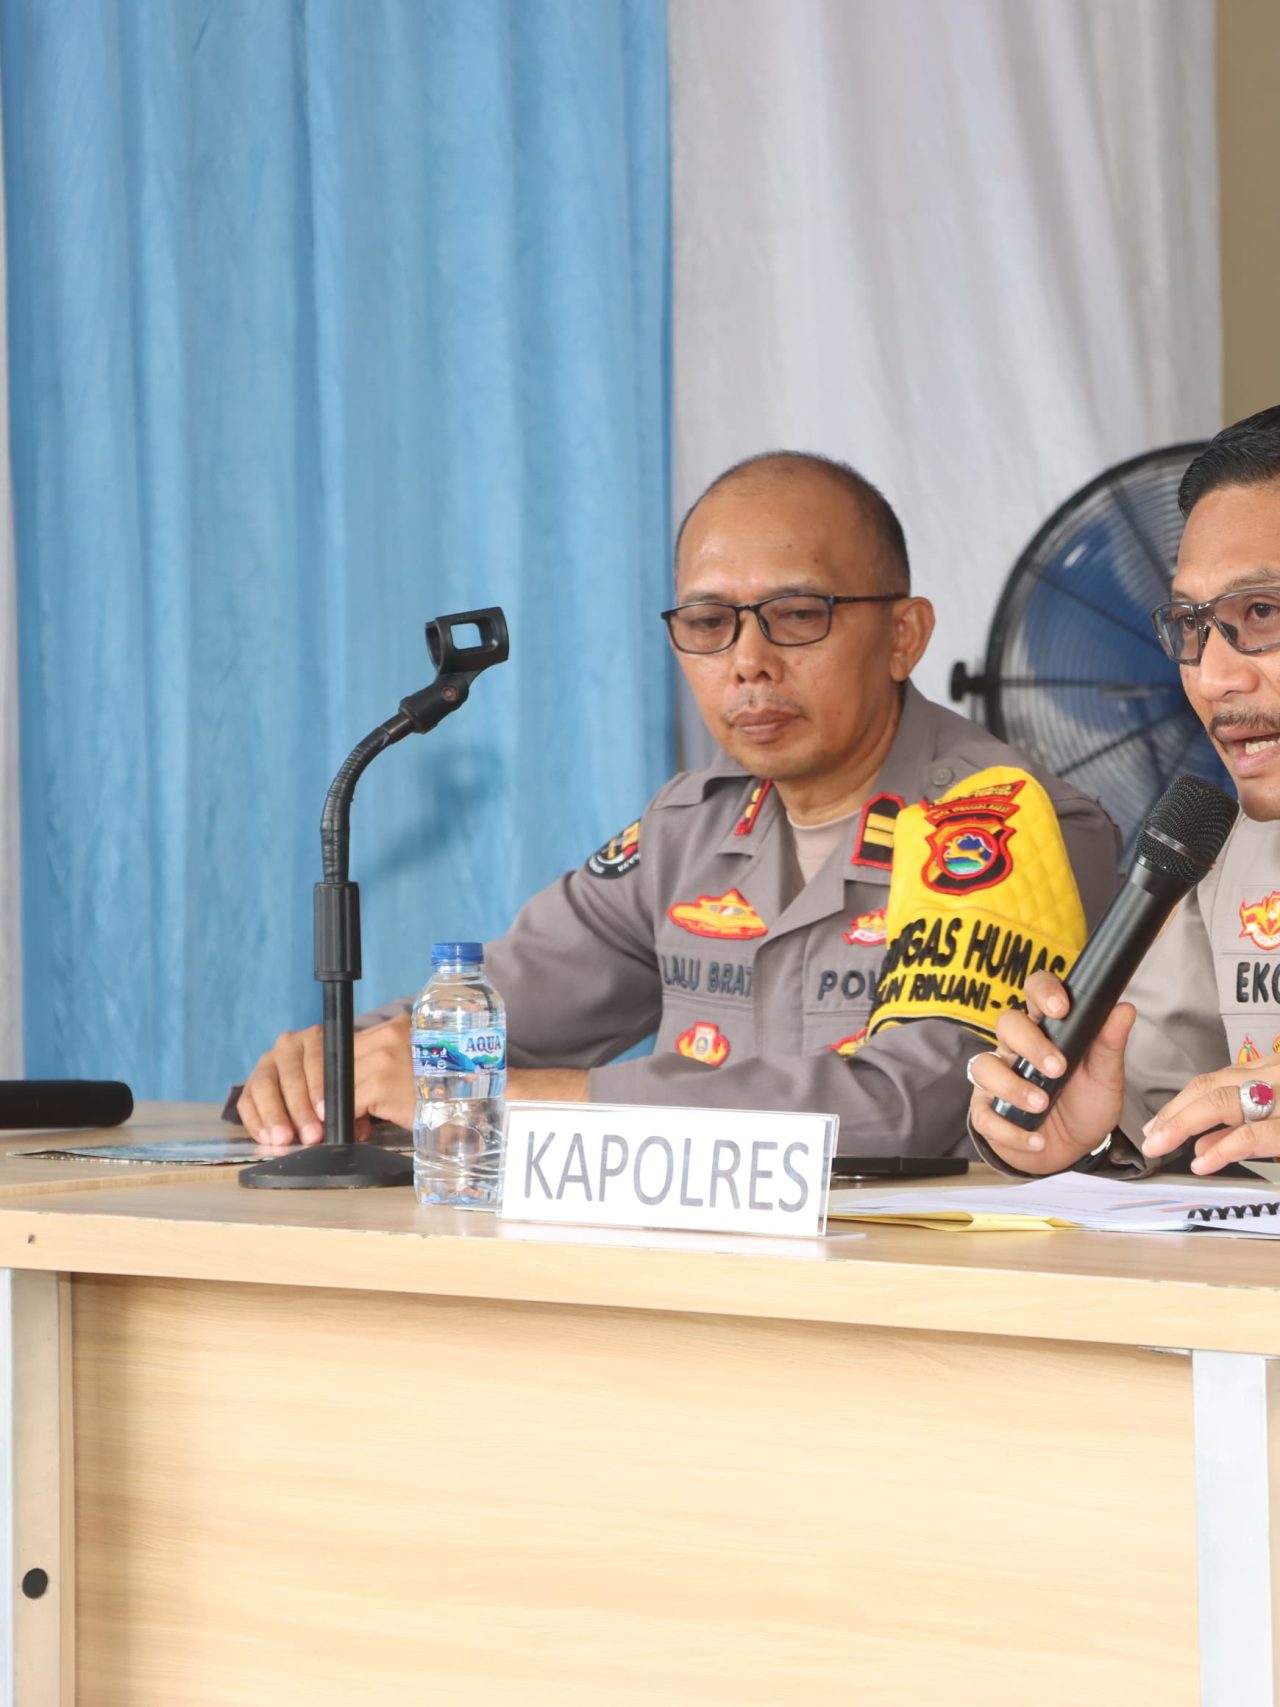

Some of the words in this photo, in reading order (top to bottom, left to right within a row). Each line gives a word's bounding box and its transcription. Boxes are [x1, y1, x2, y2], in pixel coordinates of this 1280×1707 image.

[661, 955, 701, 991] LALU
[908, 973, 990, 1012] RINJANI
[465, 1035, 502, 1053] AQUA
[524, 1131, 809, 1213] KAPOLRES
